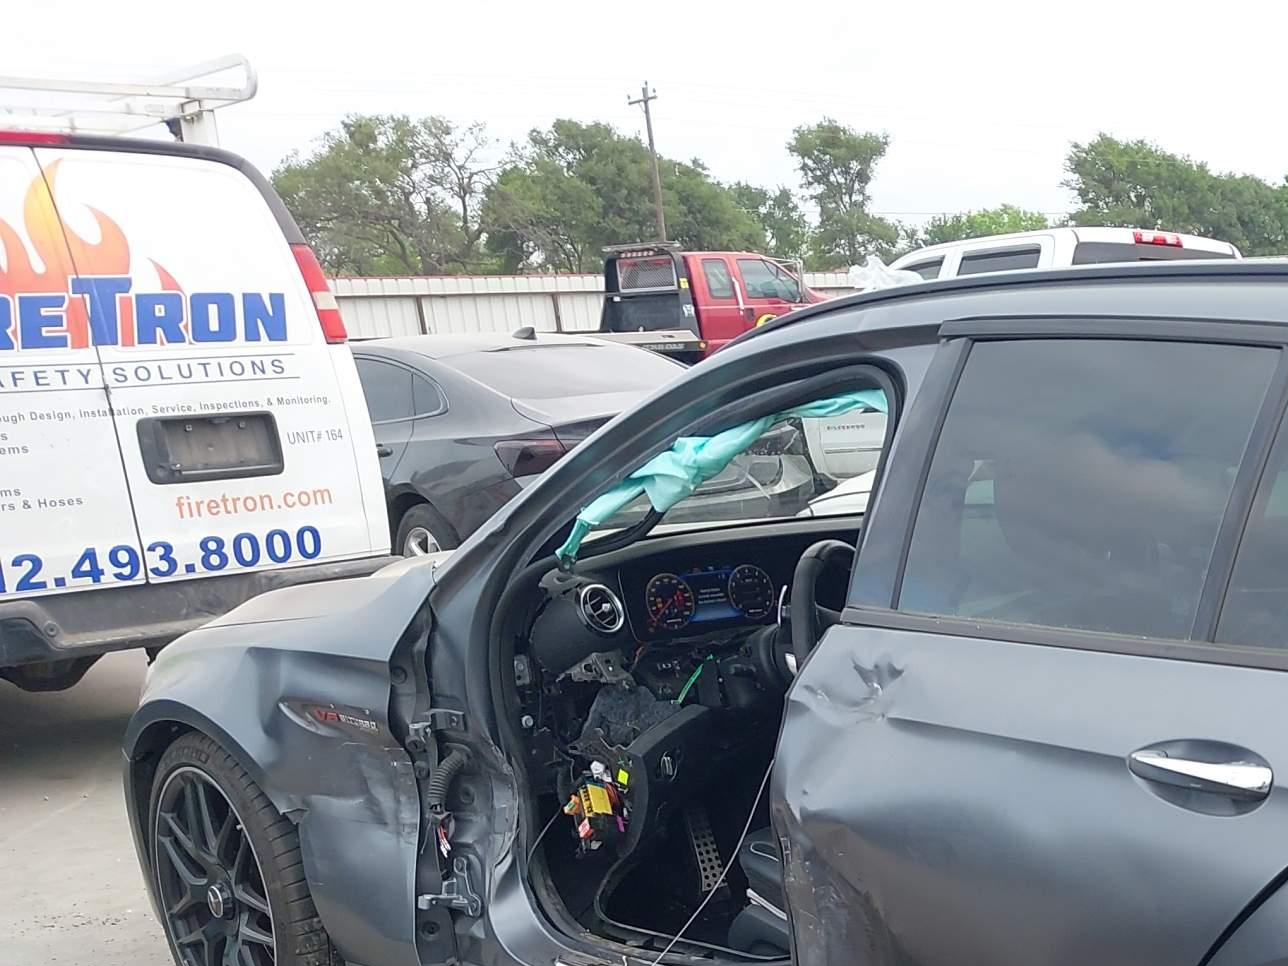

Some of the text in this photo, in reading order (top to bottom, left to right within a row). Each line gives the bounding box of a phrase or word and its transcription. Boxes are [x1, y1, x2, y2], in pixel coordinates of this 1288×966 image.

[0, 359, 285, 388] FETY SOLUTIONS
[0, 413, 25, 424] ugh
[30, 410, 76, 421] Design,
[152, 401, 197, 415] Service,
[199, 398, 264, 411] Inspections,
[267, 397, 273, 406] &
[326, 428, 343, 441] 164
[22, 499, 32, 510] &
[38, 497, 83, 509] Hoses
[175, 488, 333, 519] firetron.com
